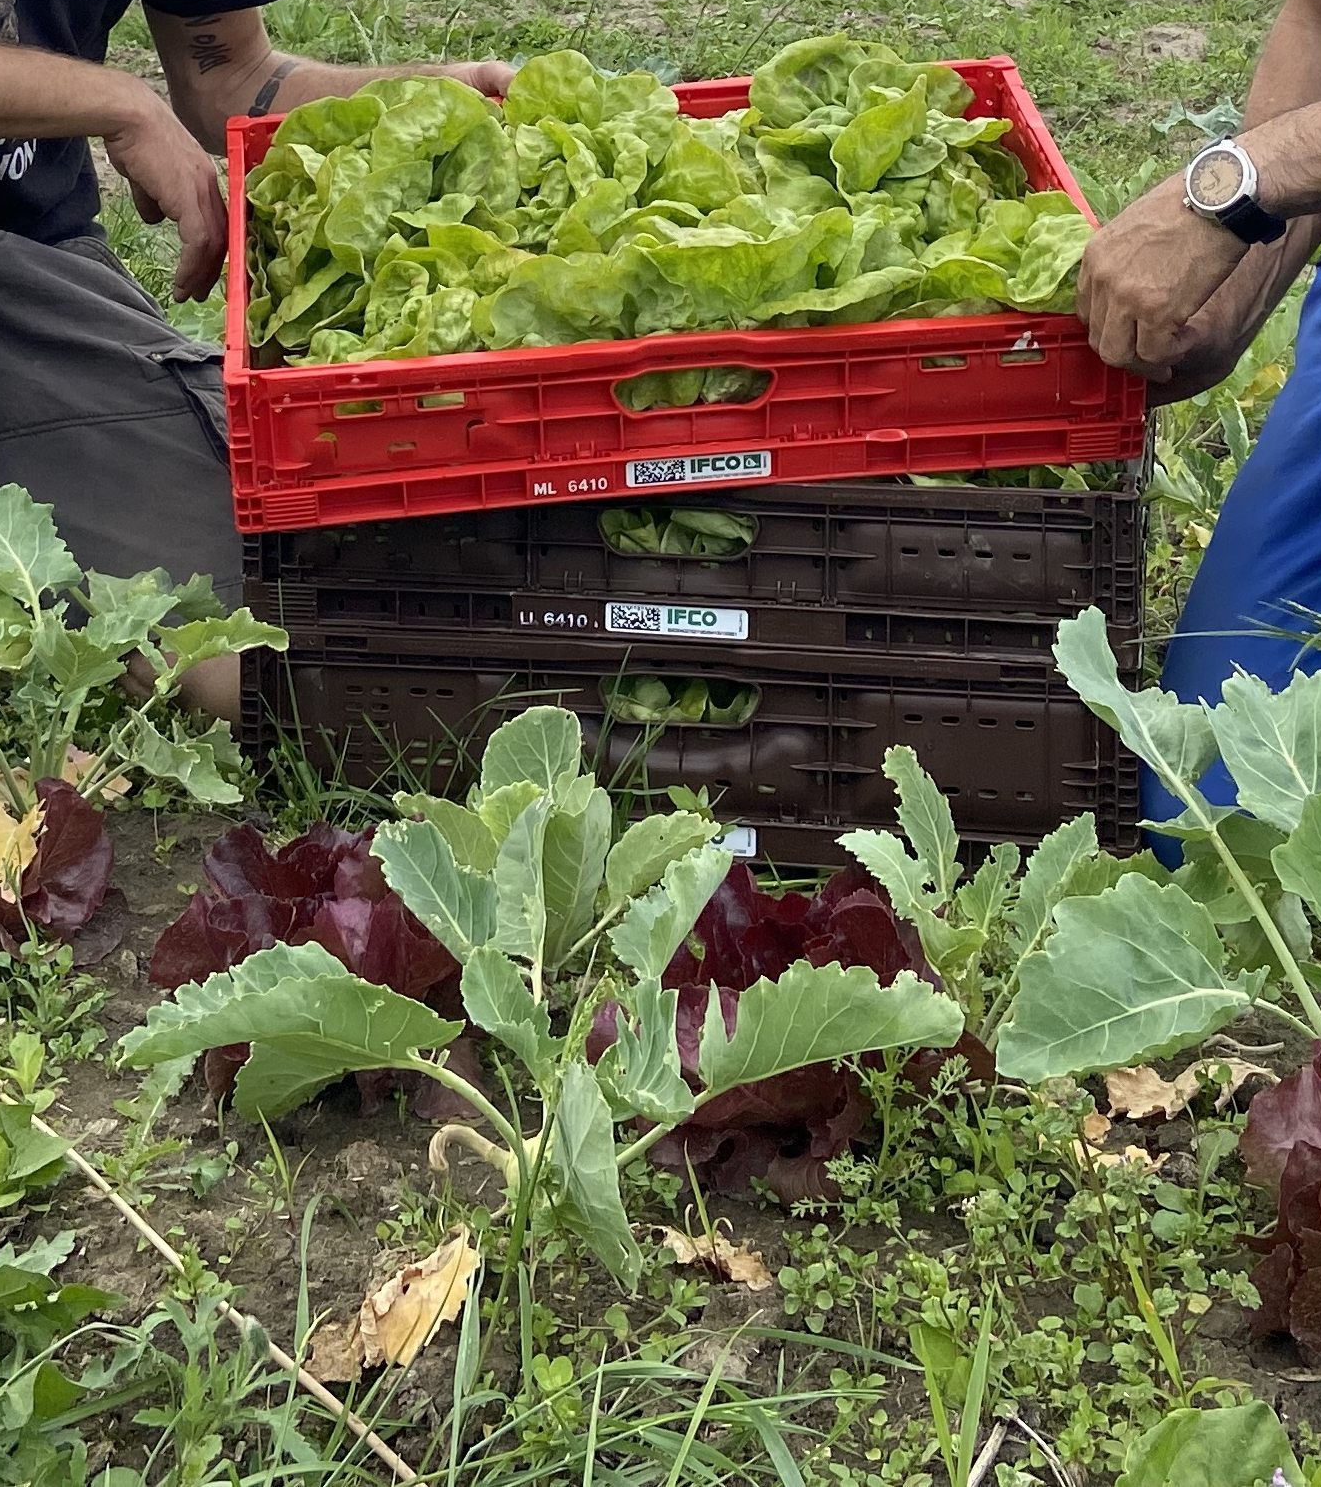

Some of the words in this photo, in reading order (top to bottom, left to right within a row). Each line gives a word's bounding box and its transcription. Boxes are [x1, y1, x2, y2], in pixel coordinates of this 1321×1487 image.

[690, 455, 740, 473] IFCO
[533, 482, 557, 496] ML
[568, 477, 608, 492] 6410
[543, 611, 588, 628] 6410
[667, 608, 717, 627] IFCO
